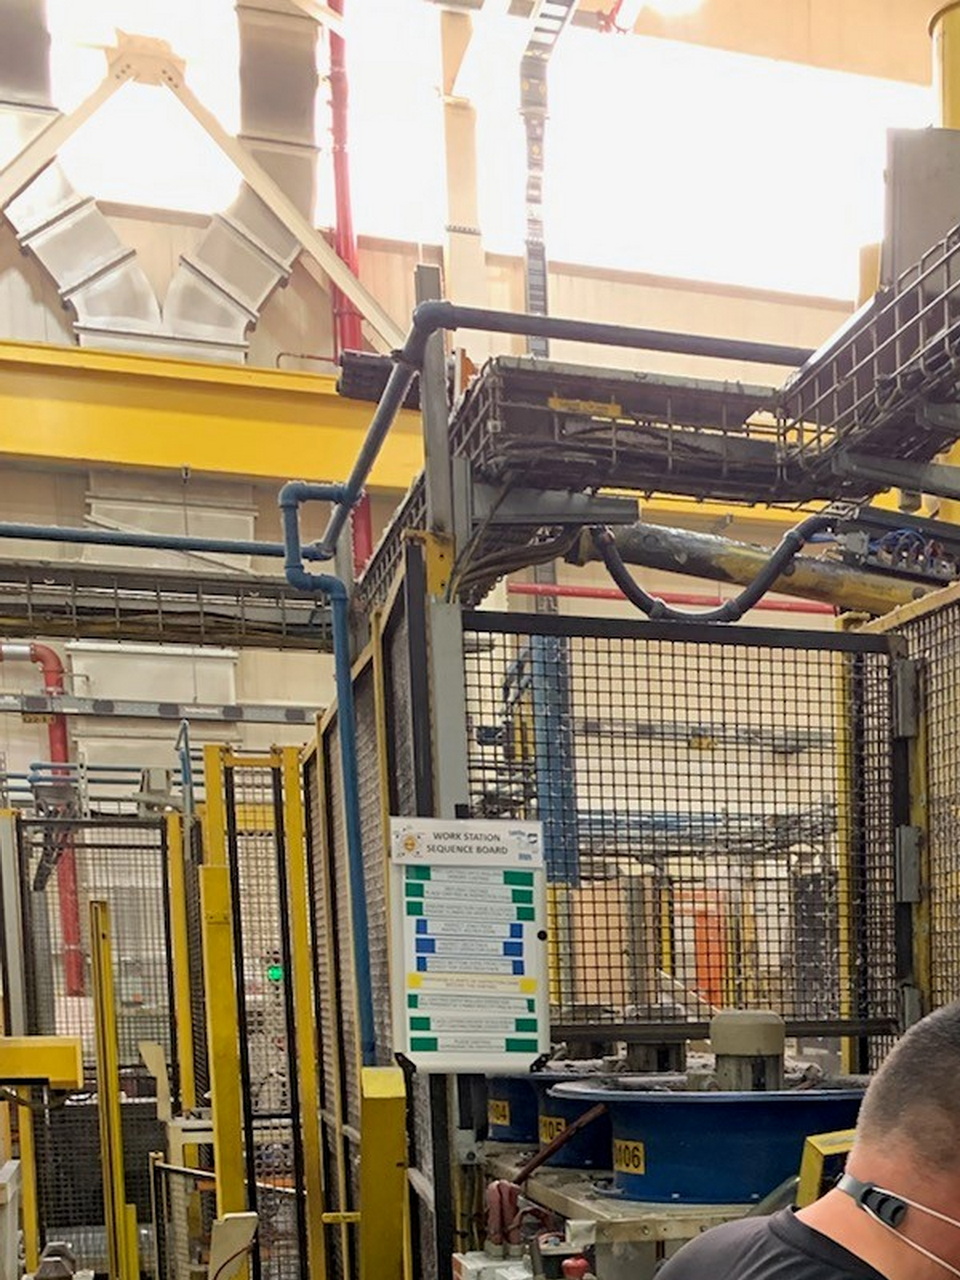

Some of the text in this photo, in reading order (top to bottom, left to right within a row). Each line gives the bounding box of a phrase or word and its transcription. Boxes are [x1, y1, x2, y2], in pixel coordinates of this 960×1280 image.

[432, 832, 462, 841] WORK
[464, 832, 501, 842] STATION
[426, 844, 508, 855] SEQUENCE BOARD
